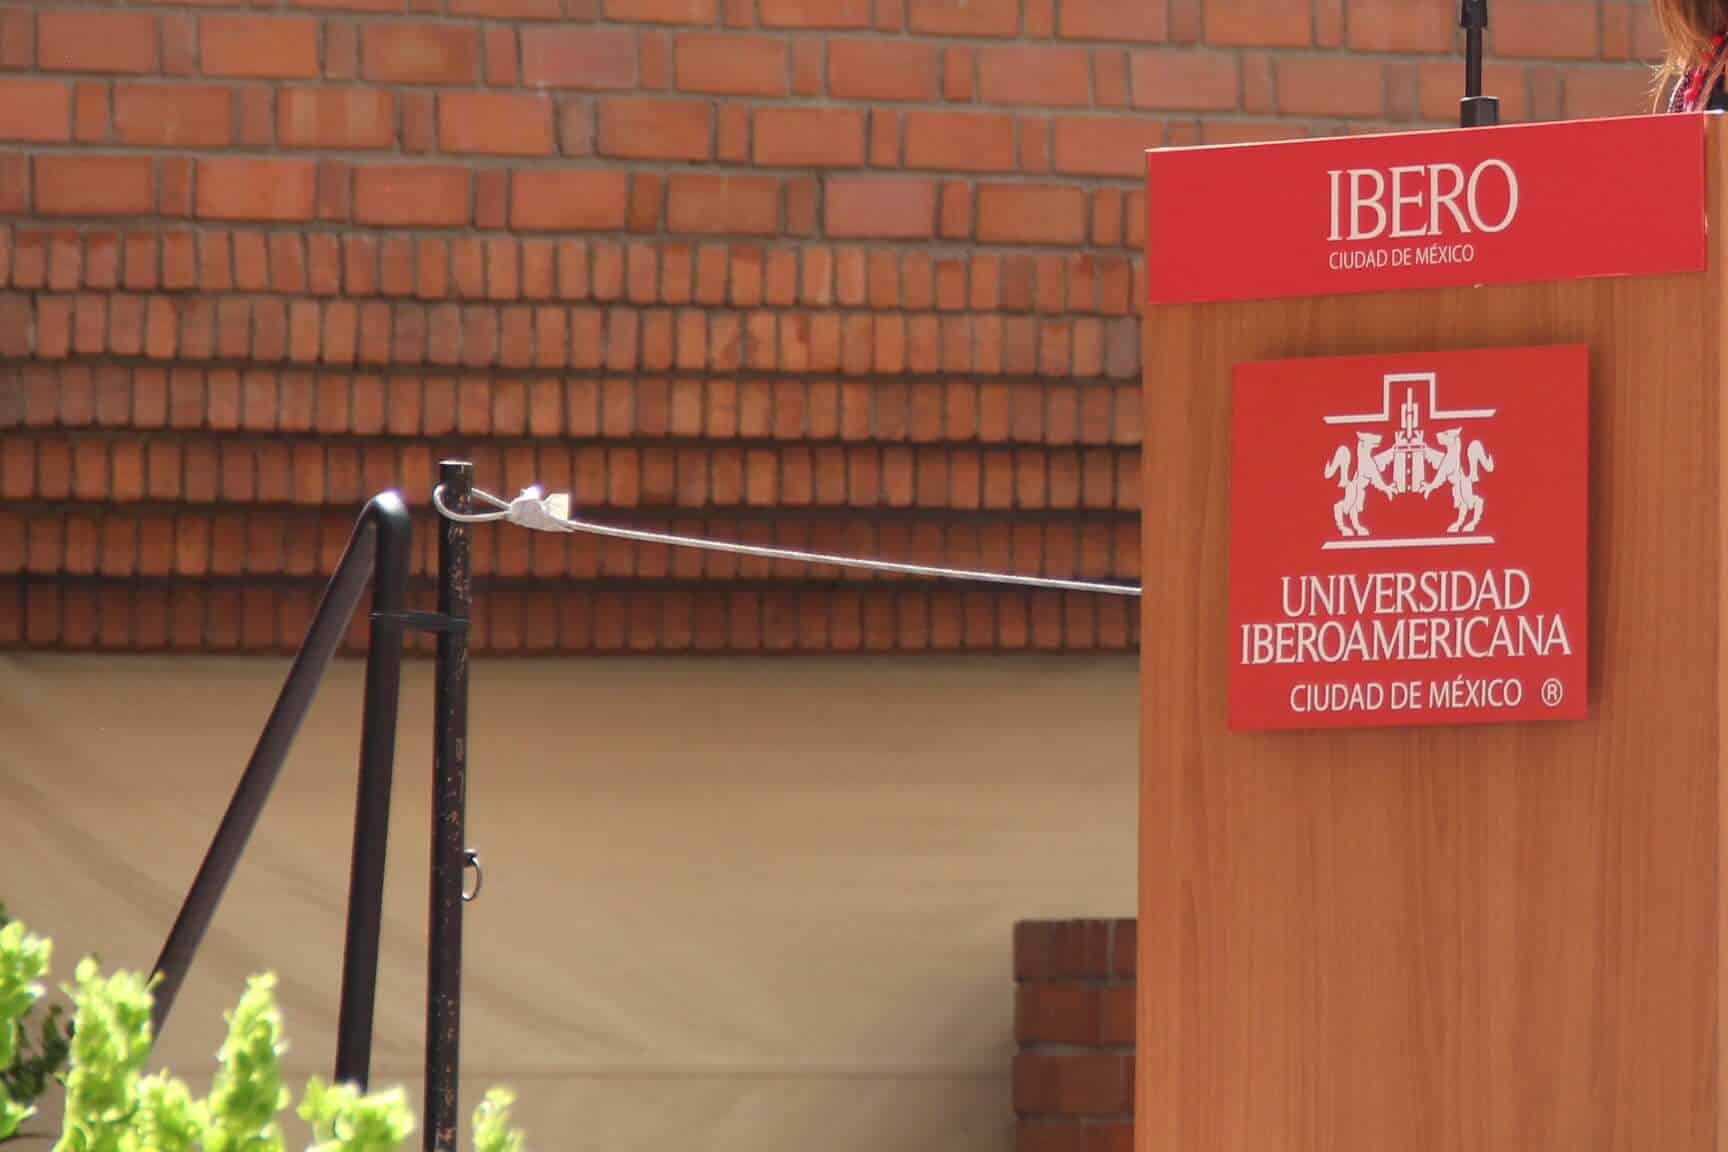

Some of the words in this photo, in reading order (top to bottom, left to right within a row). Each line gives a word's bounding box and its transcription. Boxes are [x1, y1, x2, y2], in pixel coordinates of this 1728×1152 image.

[1327, 158, 1519, 241] IBERO
[1329, 249, 1388, 270] CIUDAD
[1391, 248, 1412, 266] DE
[1415, 243, 1475, 265] MÉXICO
[1281, 568, 1530, 617] UNIVERSIDAD
[1240, 614, 1572, 665] IBEROAMERICANA
[1290, 683, 1384, 712] CIUDAD
[1391, 681, 1422, 710] DE
[1429, 675, 1522, 709] MÉXICO
